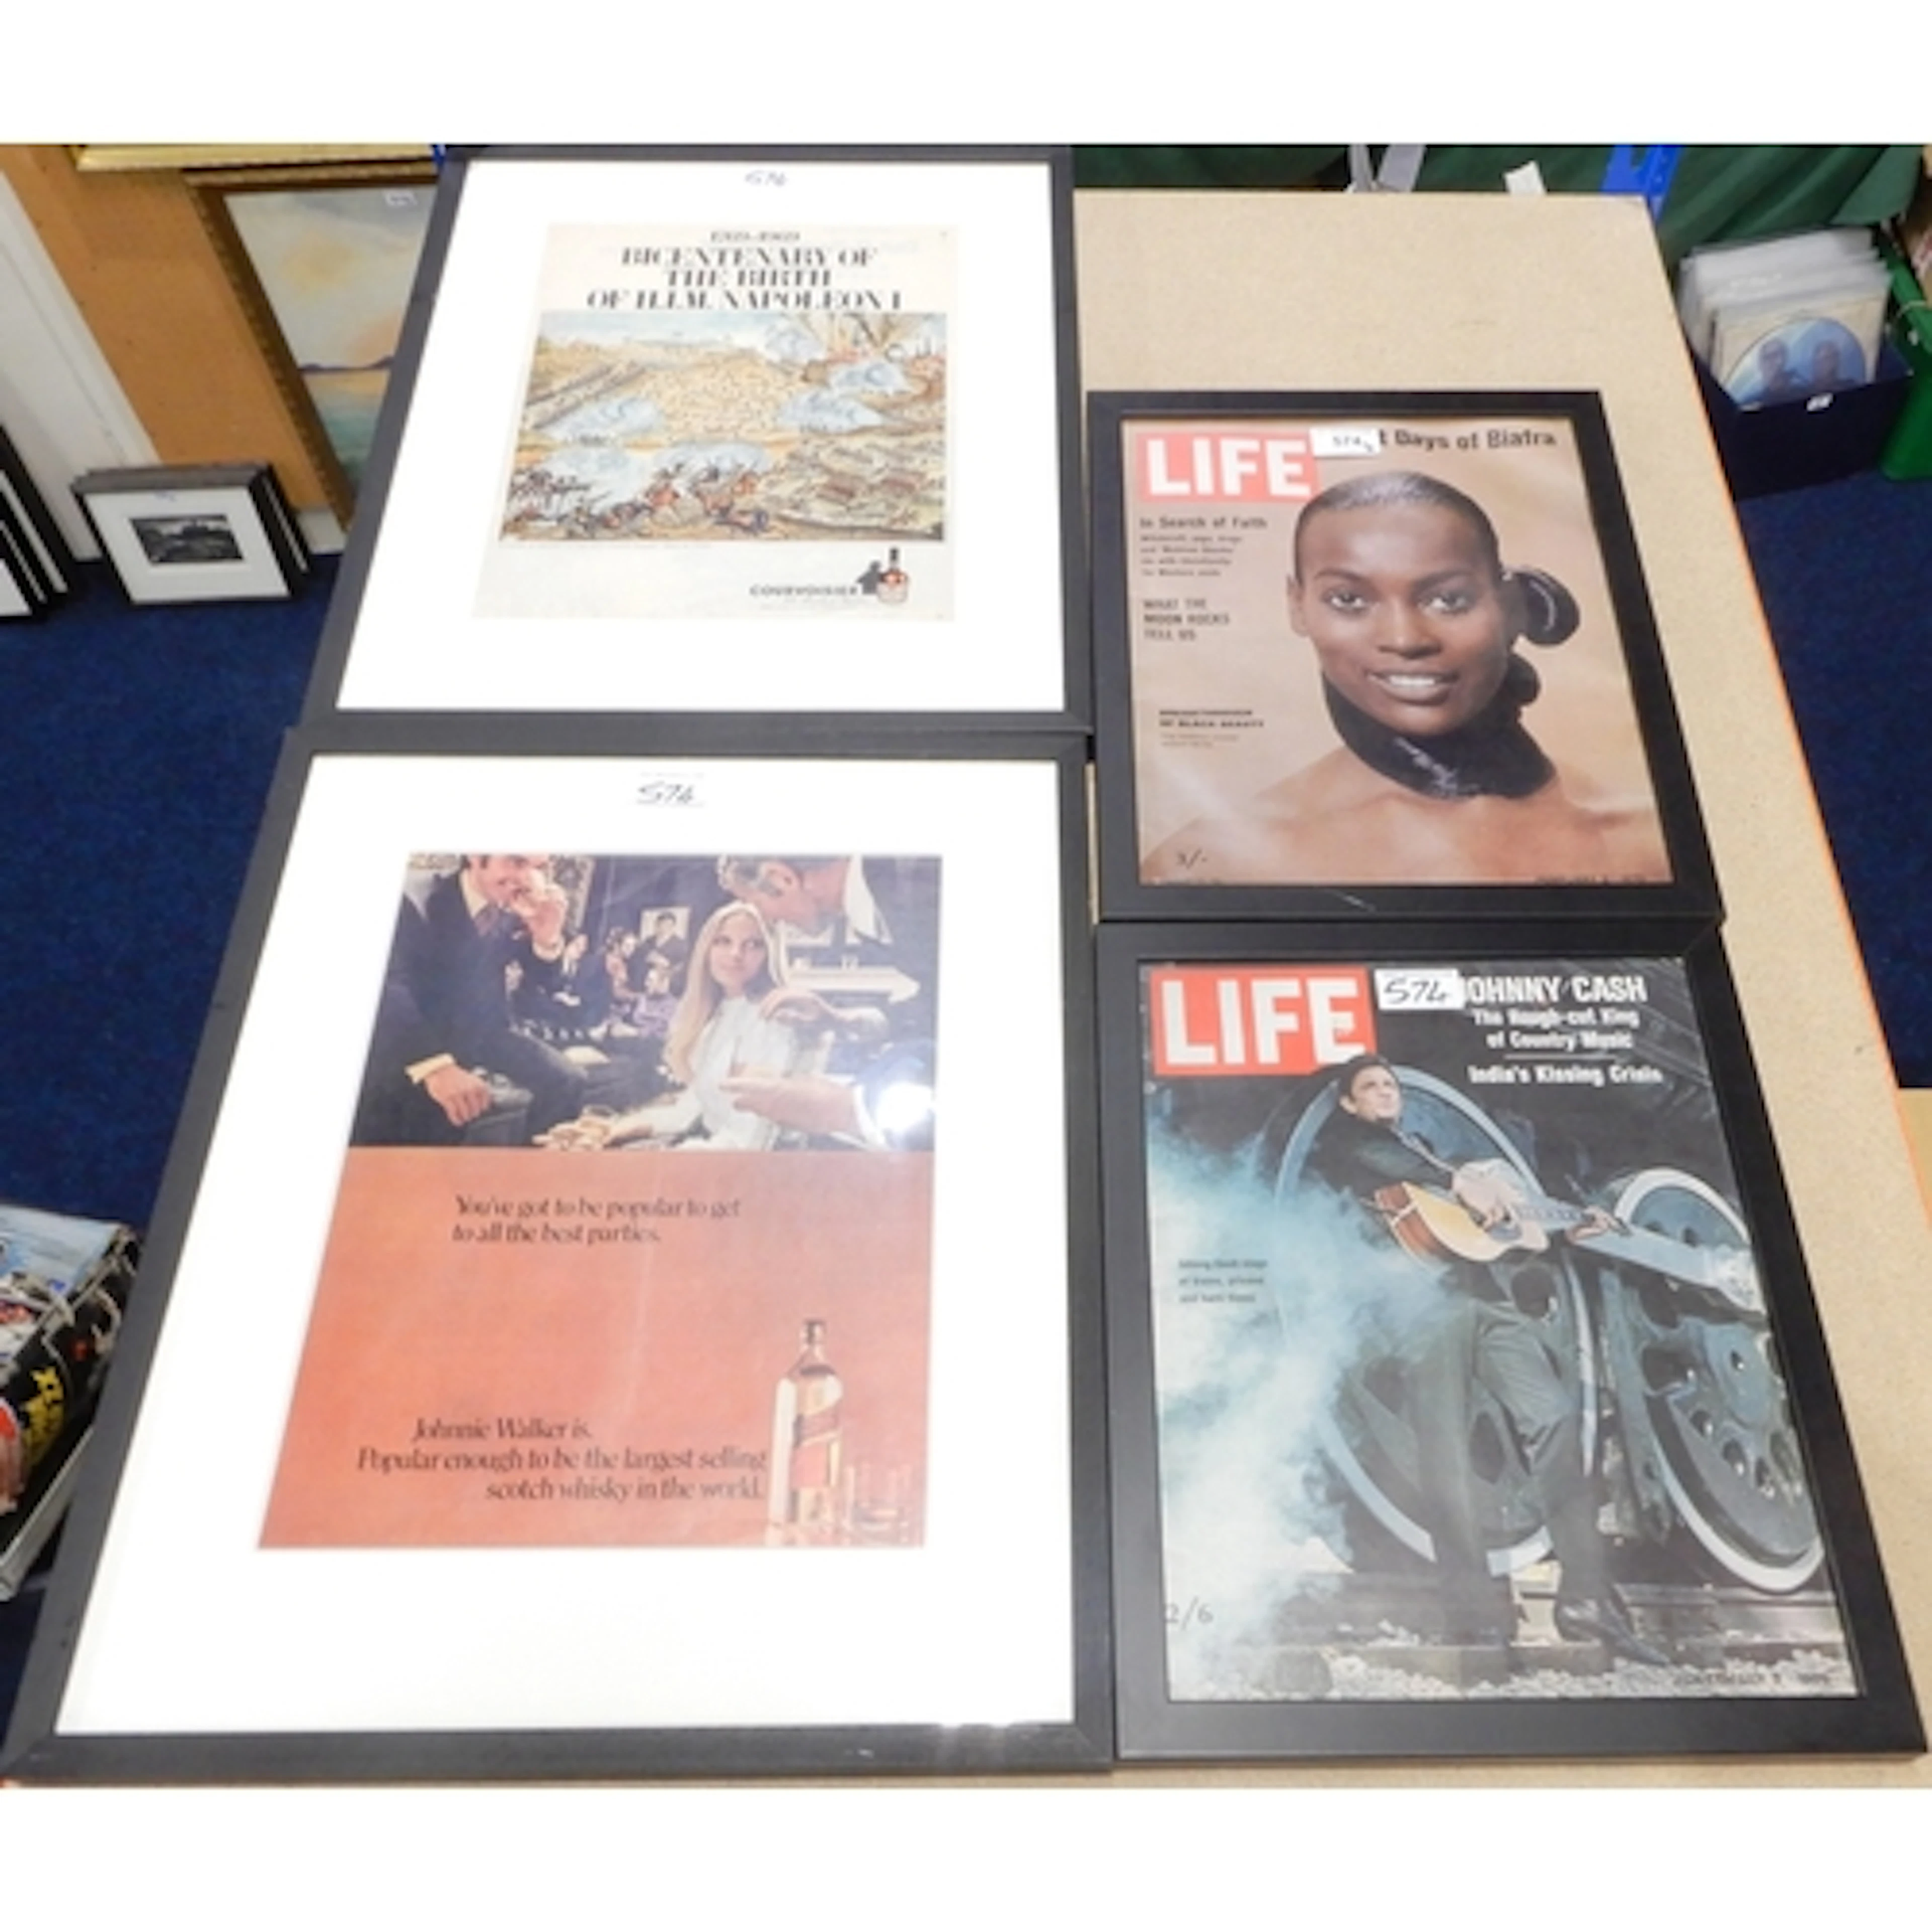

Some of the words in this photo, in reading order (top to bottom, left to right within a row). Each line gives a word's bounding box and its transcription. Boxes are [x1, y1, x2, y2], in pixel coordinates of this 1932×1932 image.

[621, 247, 828, 266] BICENTENARY
[838, 247, 877, 266] OF
[667, 269, 726, 287] THE
[738, 269, 832, 287] BIRTH
[587, 290, 629, 309] OF
[725, 290, 881, 309] NAPOLEON
[1394, 429, 1450, 451] Days
[1457, 434, 1479, 451] of
[1487, 428, 1557, 449] Biafra
[1147, 439, 1310, 497] LIFE
[1158, 517, 1206, 528] Search
[1232, 517, 1267, 529] Faith
[1143, 614, 1182, 624] MOON
[636, 780, 694, 805] 574
[1383, 978, 1450, 1005] 574
[1463, 976, 1561, 1003] OHNNY
[1571, 976, 1648, 1003] CASH
[1160, 978, 1365, 1066] LIFE
[1472, 1008, 1505, 1026] The
[1600, 1008, 1640, 1029] King
[1486, 1031, 1505, 1049] of
[1509, 1031, 1576, 1052] Country
[1579, 1031, 1633, 1049] Music
[1467, 1065, 1531, 1084] India's
[1535, 1065, 1605, 1087] Kissing
[1611, 1066, 1663, 1084] Crisis
[456, 1194, 513, 1217] You've
[517, 1198, 549, 1218] got
[555, 1198, 577, 1216] to
[580, 1196, 604, 1217] be
[606, 1198, 682, 1221] popular
[687, 1199, 707, 1217] to
[710, 1199, 741, 1219] get
[452, 1224, 475, 1241] to
[476, 1221, 502, 1242] all
[506, 1222, 537, 1243] the
[540, 1222, 584, 1244] best
[411, 1417, 492, 1442] Johnnie
[496, 1417, 568, 1438] Walker
[357, 1446, 442, 1475] Popular
[443, 1447, 523, 1473] enough
[528, 1449, 551, 1470] to
[554, 1446, 580, 1469] be
[584, 1446, 619, 1469] the
[623, 1446, 693, 1472] largest
[698, 1445, 767, 1472] selling
[486, 1478, 554, 1500] scotch
[559, 1476, 633, 1503] whisky
[636, 1477, 658, 1499] in
[660, 1476, 695, 1499] the
